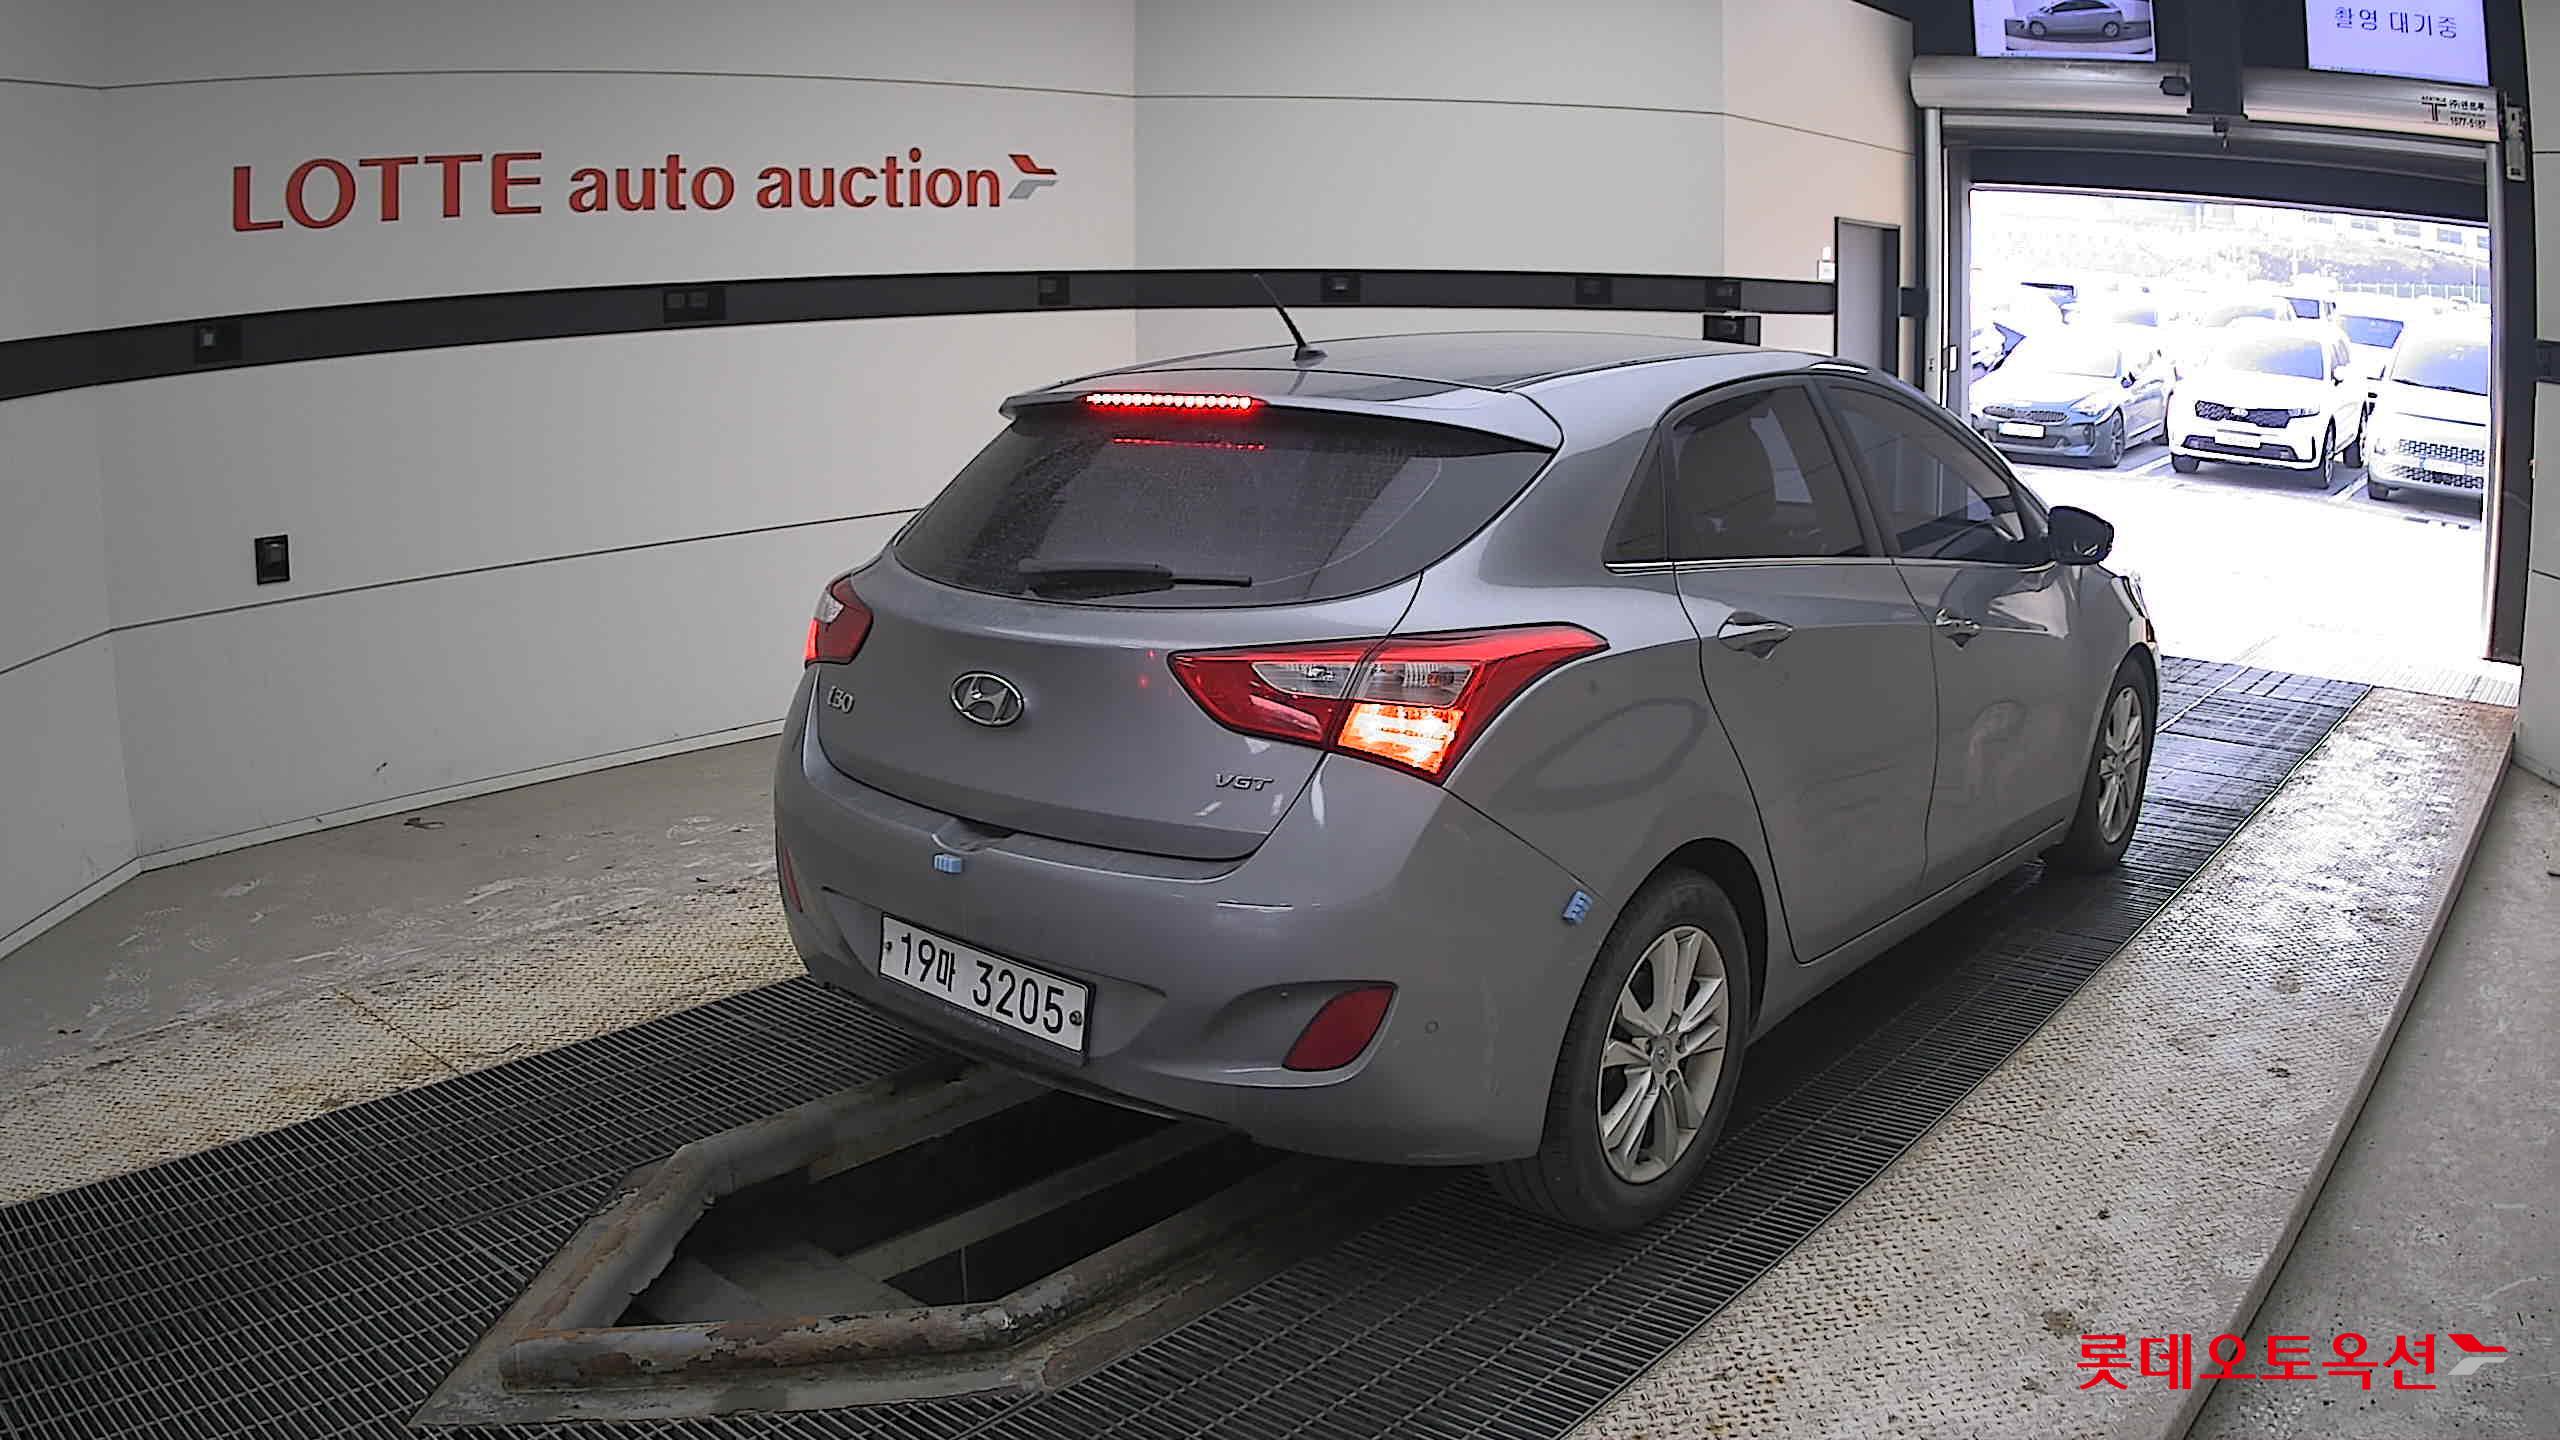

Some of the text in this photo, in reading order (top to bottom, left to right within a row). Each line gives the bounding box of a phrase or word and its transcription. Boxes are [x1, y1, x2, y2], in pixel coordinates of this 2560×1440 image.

[2335, 6, 2457, 39] 촬영 대기중
[234, 147, 1003, 231] LOTTE auto auction
[1216, 774, 1274, 791] VGT
[900, 932, 955, 993] 19마
[972, 959, 1065, 1035] 3205
